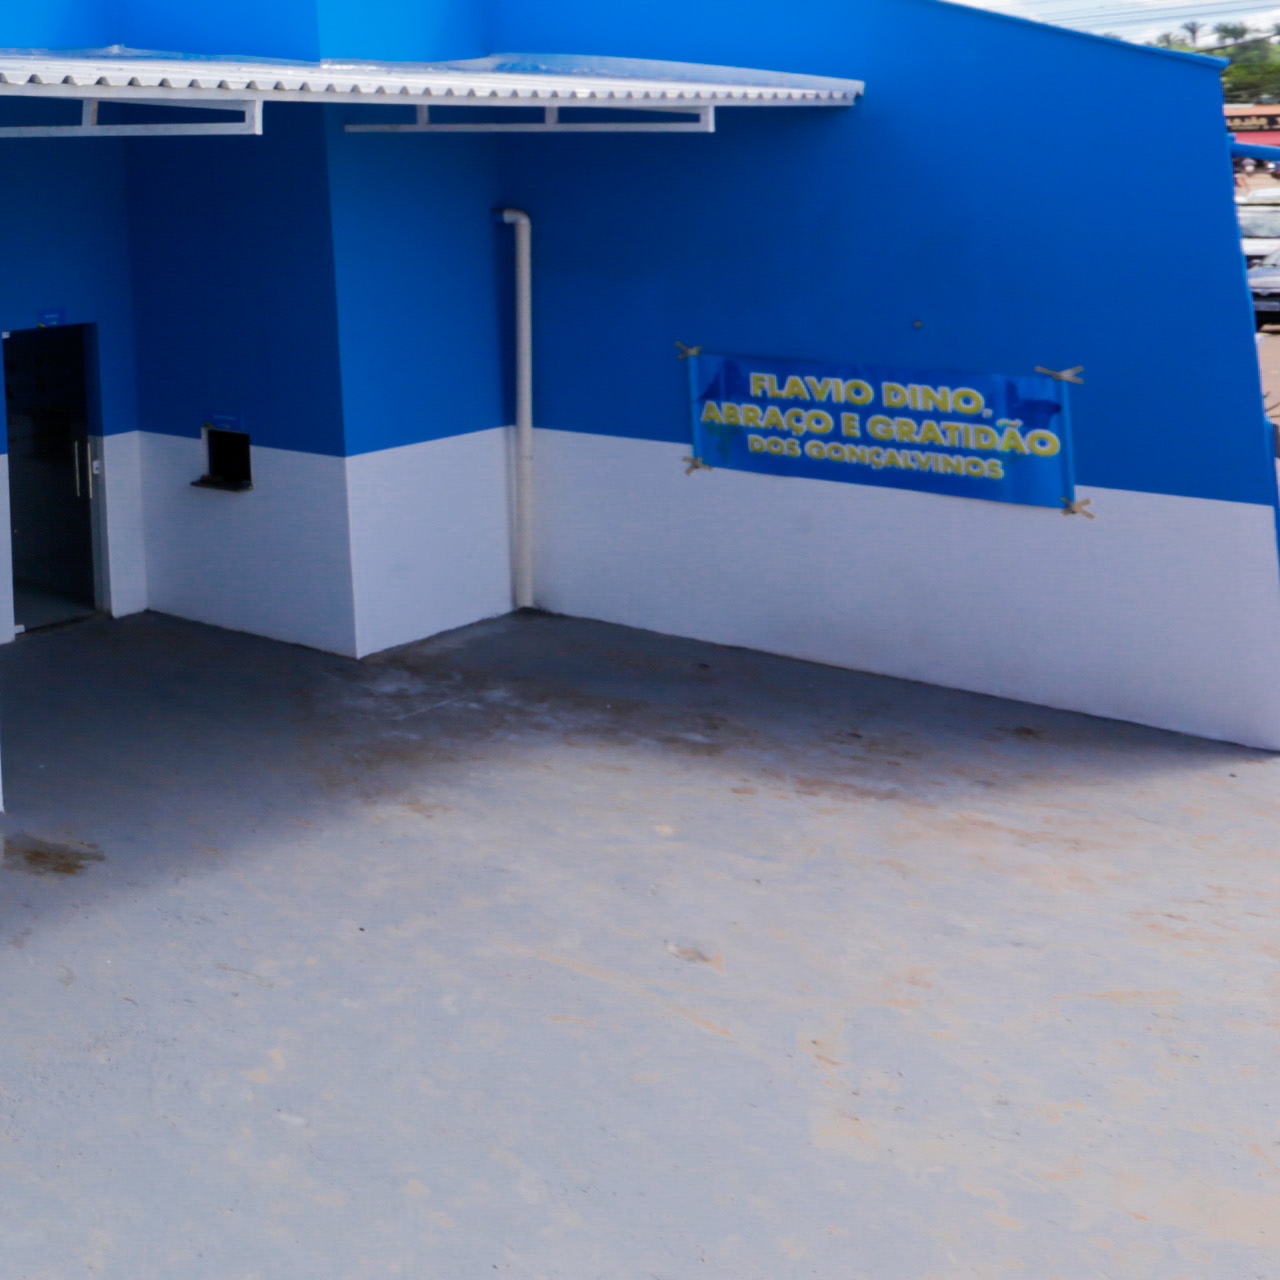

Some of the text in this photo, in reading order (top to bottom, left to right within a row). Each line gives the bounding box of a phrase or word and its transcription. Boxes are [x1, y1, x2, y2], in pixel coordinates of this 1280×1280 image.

[749, 372, 993, 418] FLAVIO DINO,
[702, 400, 1061, 457] ABRAÇO E GRATIDÃO
[748, 434, 801, 457] DOS
